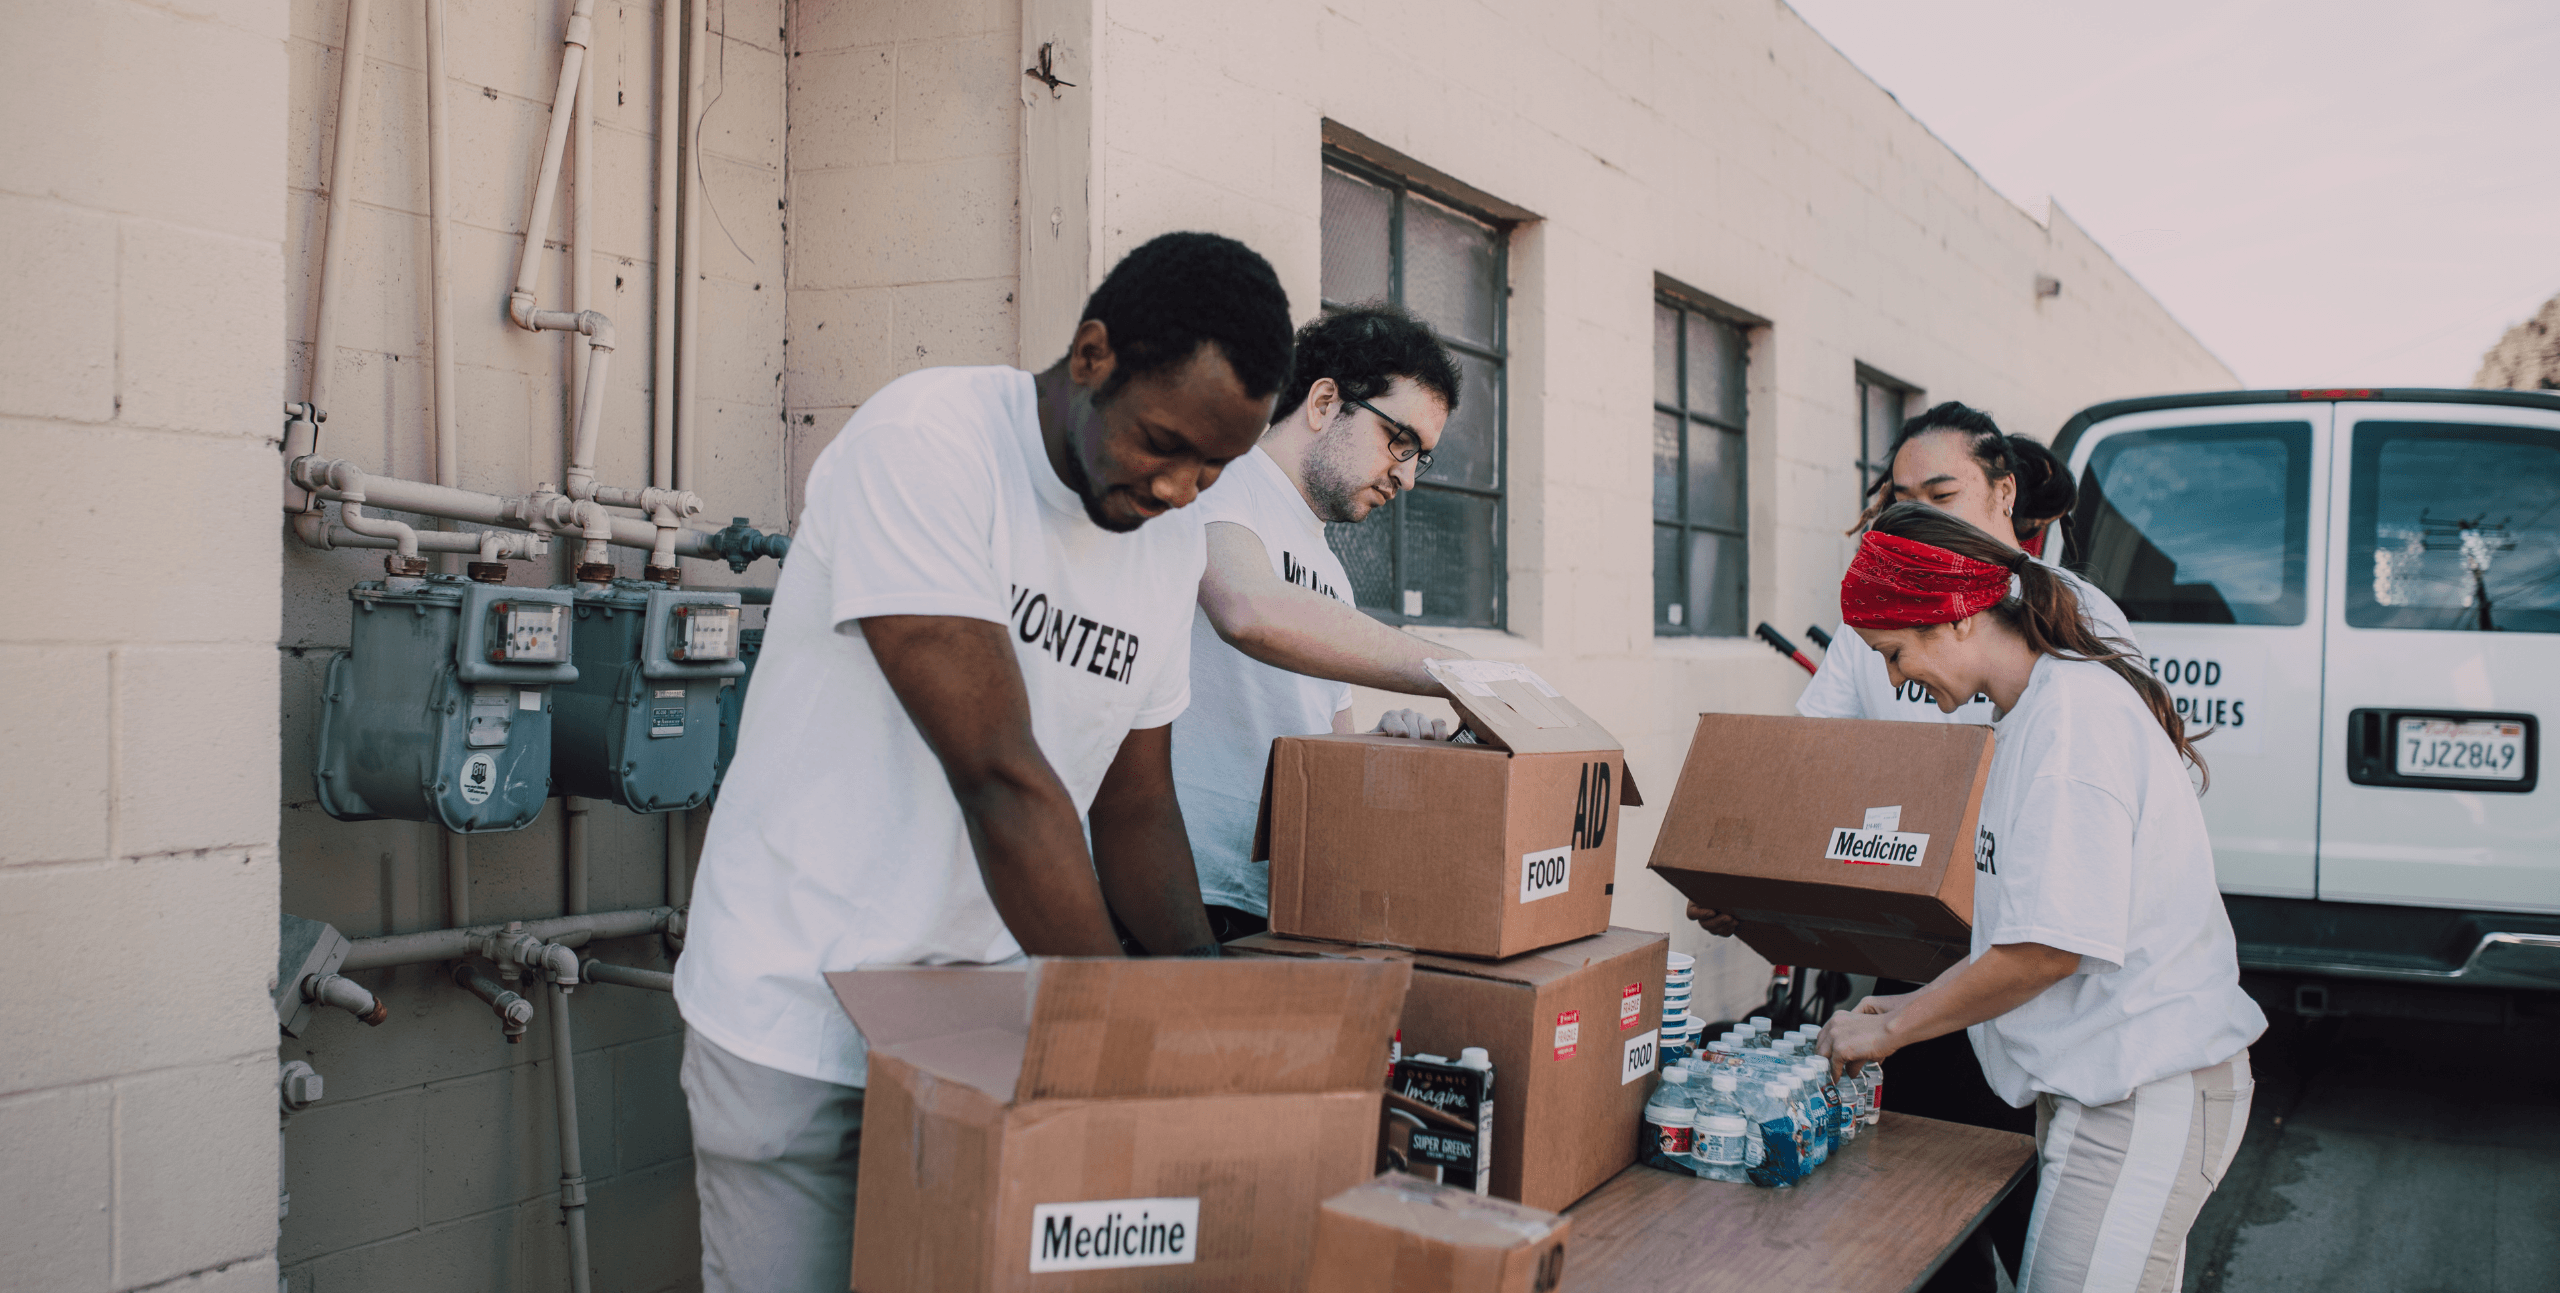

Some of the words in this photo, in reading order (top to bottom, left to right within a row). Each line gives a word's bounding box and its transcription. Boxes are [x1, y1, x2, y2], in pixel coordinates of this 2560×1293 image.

[1012, 584, 1139, 685] VOLNTEER
[2149, 657, 2222, 686] FOOD
[2176, 698, 2245, 727] PLIES
[472, 762, 487, 776] 811
[2407, 739, 2515, 770] 7J22849
[1571, 762, 1611, 851] AID
[1833, 831, 1918, 862] Medicine
[1527, 856, 1565, 892] FOOD
[1628, 1042, 1652, 1072] FOOD
[1407, 1070, 1467, 1086] ORGANIC
[1404, 1078, 1469, 1110] Imagine
[1413, 1134, 1440, 1151] SUPER
[1442, 1138, 1471, 1158] GREENS
[1042, 1211, 1186, 1260] Medicine
